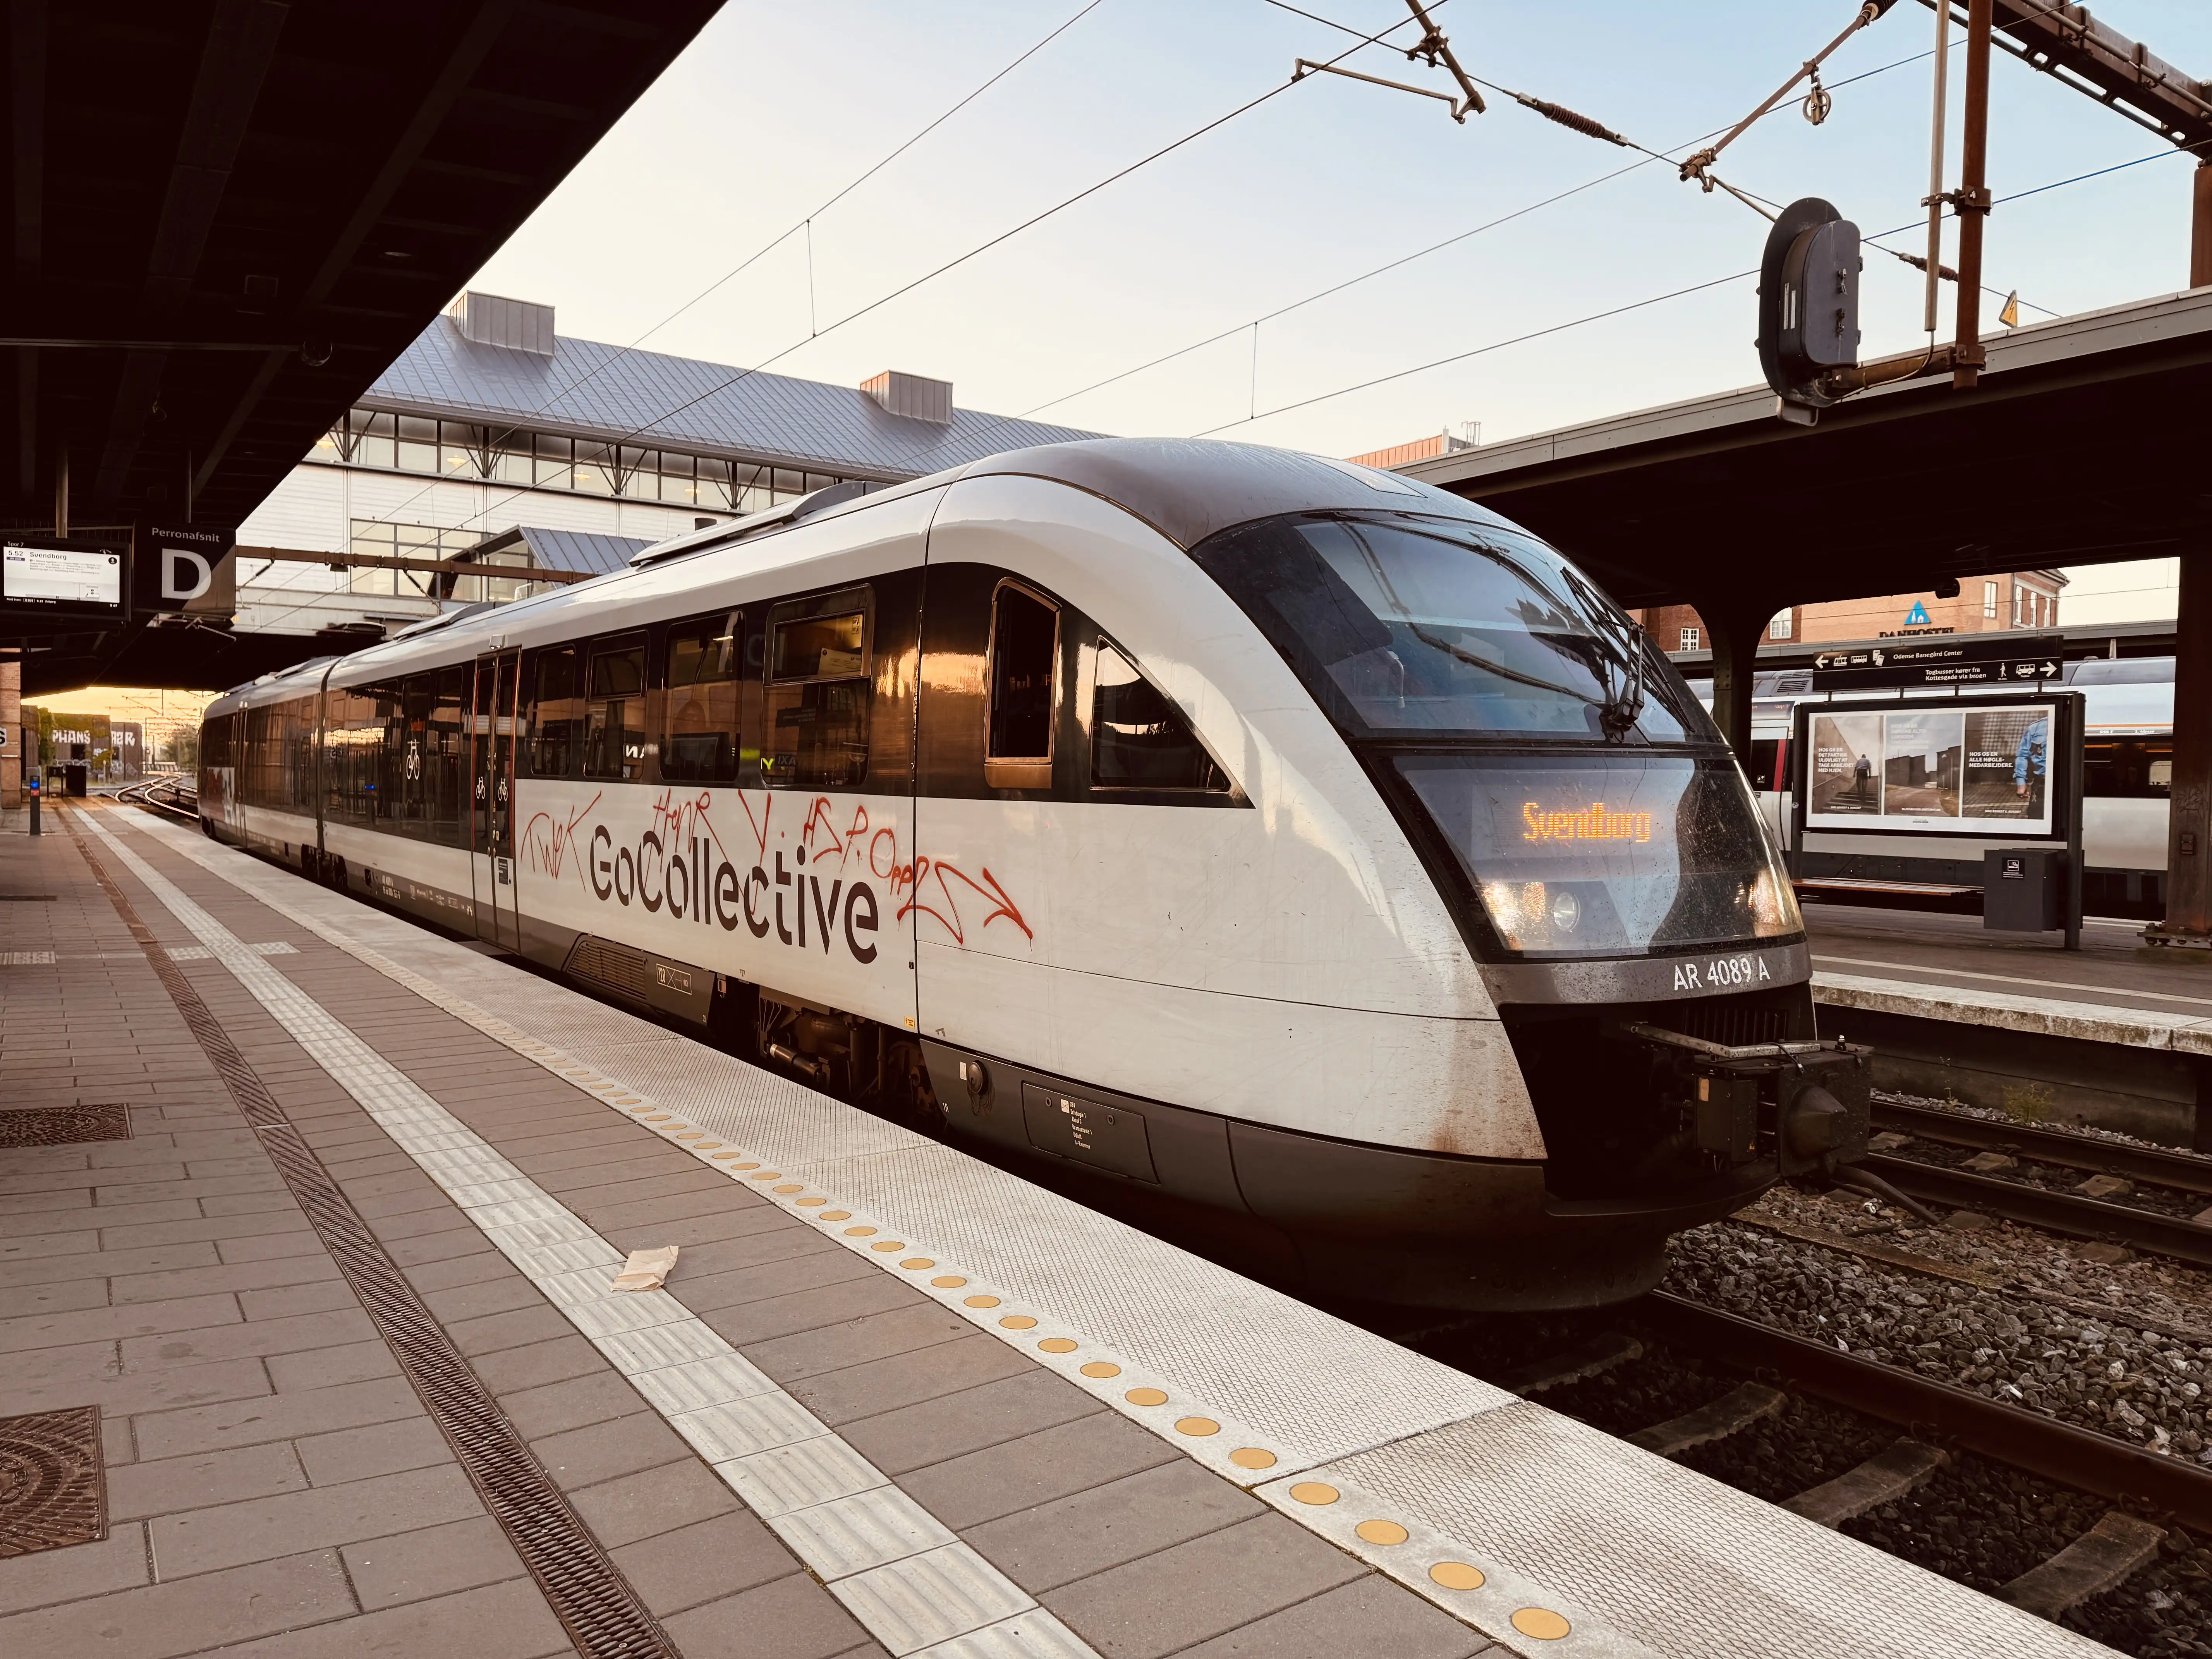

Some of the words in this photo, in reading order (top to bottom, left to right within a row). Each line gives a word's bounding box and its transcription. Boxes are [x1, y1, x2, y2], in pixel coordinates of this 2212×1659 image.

[152, 527, 220, 542] Perronafsnit
[30, 552, 67, 560] Svendborg
[161, 548, 211, 599] D
[1523, 802, 1651, 843] Svendborg
[590, 825, 878, 964] GoCollective
[1674, 964, 1703, 991] AR
[1707, 958, 1752, 986] 4089
[1759, 956, 1771, 981] A
